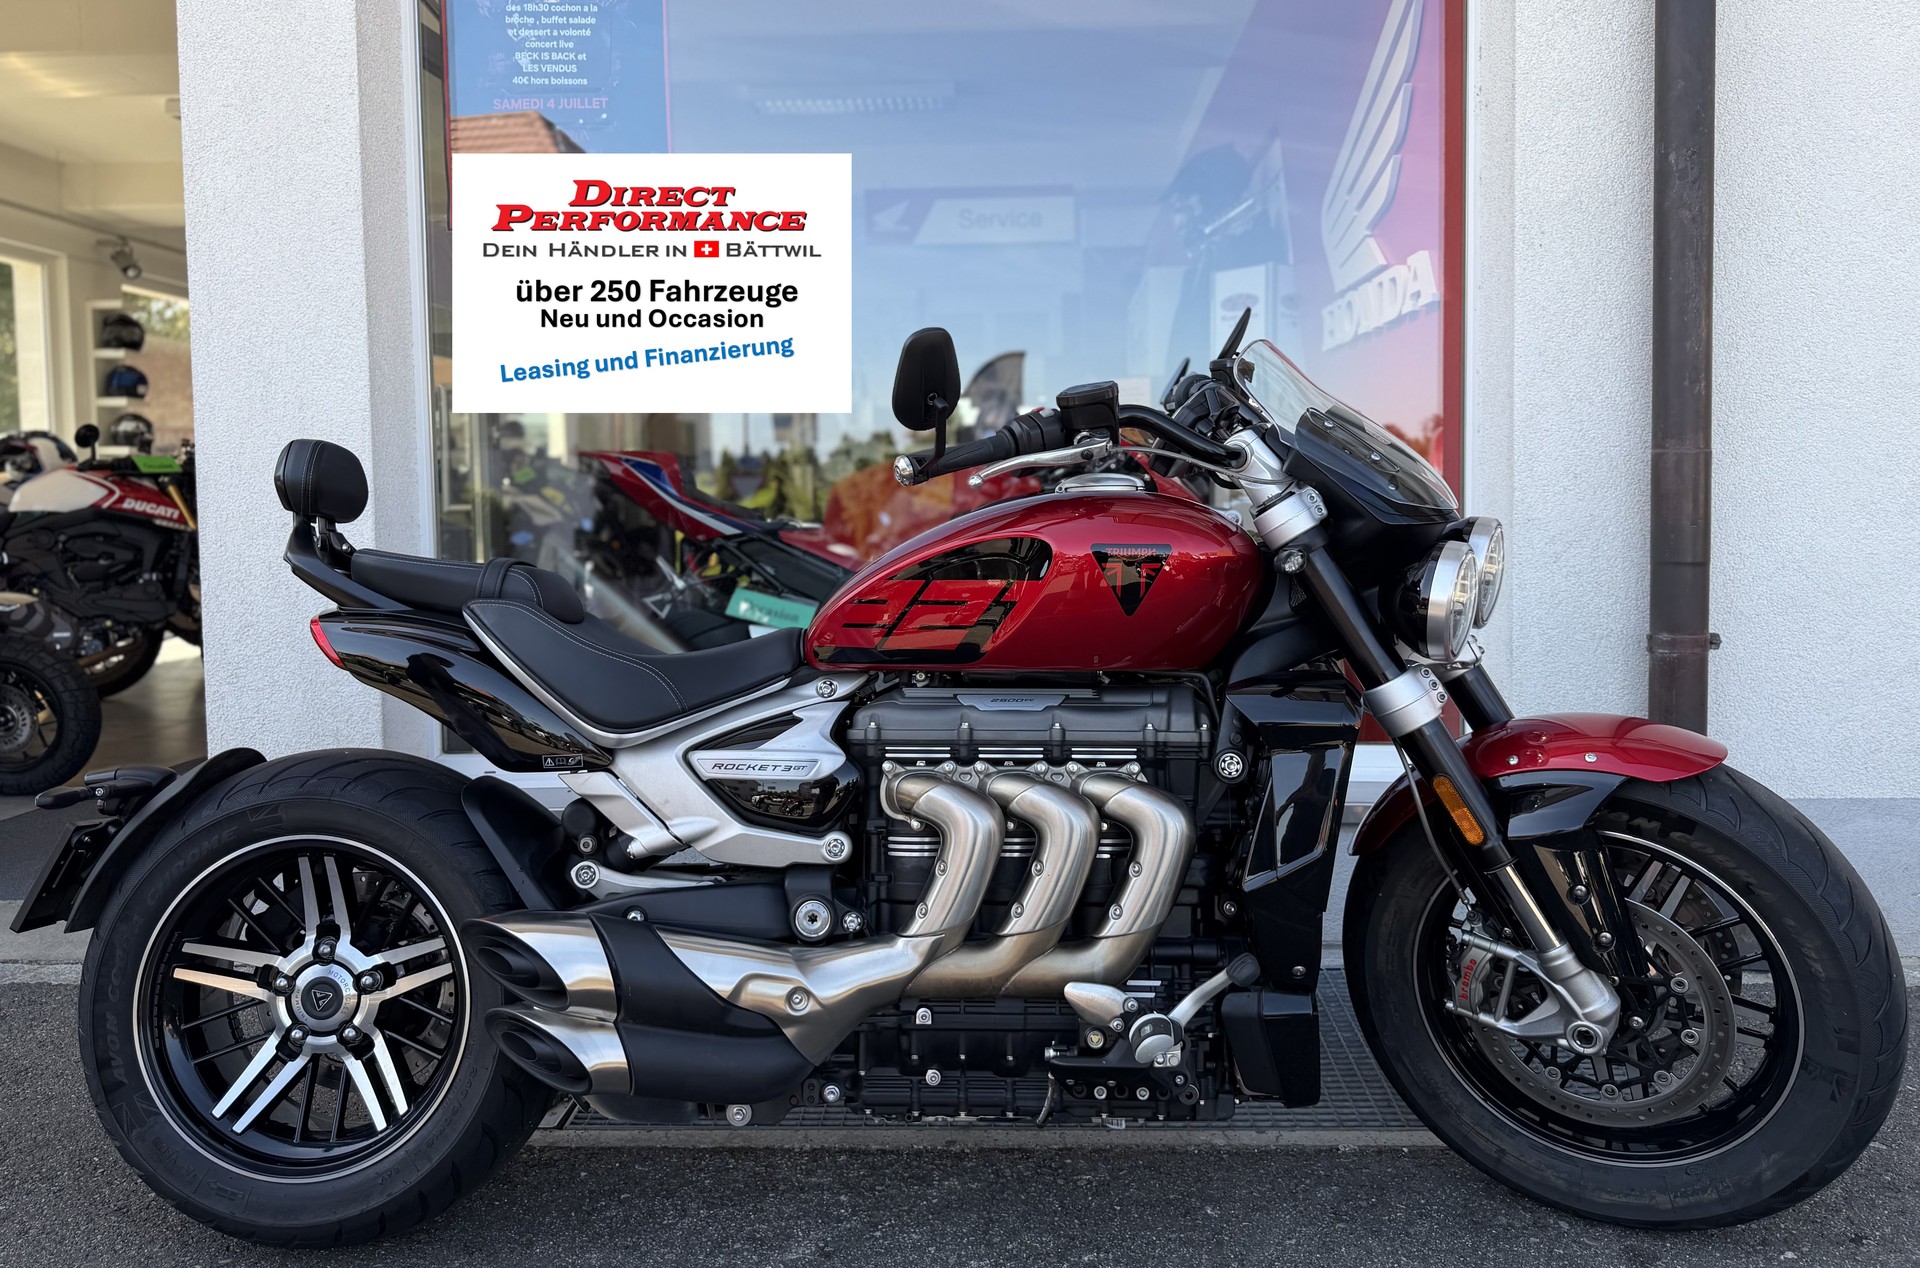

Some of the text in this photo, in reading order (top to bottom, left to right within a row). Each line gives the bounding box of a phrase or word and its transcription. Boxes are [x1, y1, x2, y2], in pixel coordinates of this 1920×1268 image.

[523, 3, 549, 12] 18h30
[550, 3, 581, 12] cochon
[590, 3, 598, 12] la
[541, 15, 567, 24] buffet
[568, 15, 597, 24] salade
[518, 28, 551, 37] dessert
[559, 27, 592, 36] volonté
[525, 40, 575, 49] concert live
[514, 52, 587, 61] BECK IS BACK et
[522, 64, 578, 73] LES VENDUS
[512, 76, 588, 86] 40€ hors boissons
[493, 97, 608, 110] SAMEDI 4 JUILLET
[958, 208, 1043, 230] Service
[122, 498, 180, 519] DUCATI
[1106, 547, 1157, 557] TRIUMPH
[1458, 958, 1477, 1000] brembo
[293, 968, 352, 1023] TRIUMPH MOTORCYCLES
